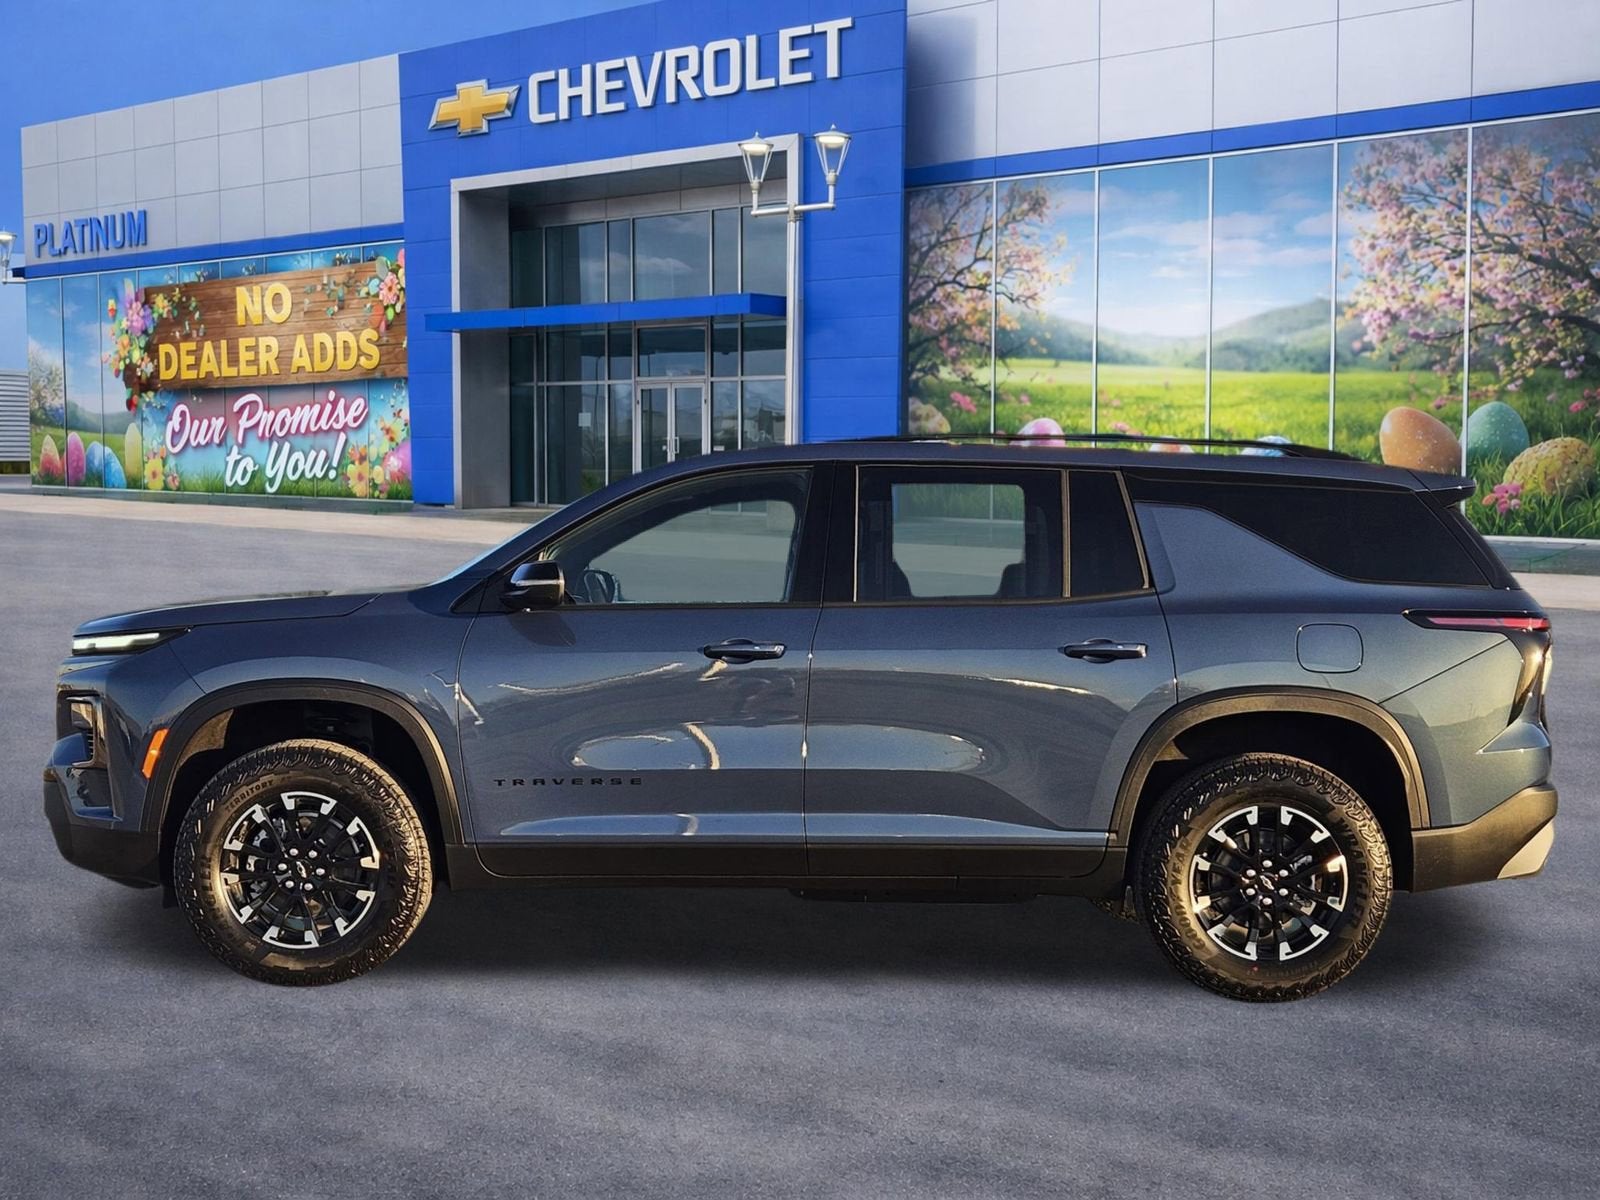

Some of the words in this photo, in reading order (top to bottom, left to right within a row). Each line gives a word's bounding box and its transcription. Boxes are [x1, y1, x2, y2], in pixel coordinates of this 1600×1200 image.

[527, 16, 855, 125] CHEVROLET
[33, 209, 148, 258] PLATINUM
[235, 282, 293, 326] NO
[158, 335, 280, 380] DEALER
[290, 328, 382, 374] ADDS
[165, 403, 228, 455] Our
[232, 390, 369, 444] Promise
[225, 446, 259, 487] to
[264, 431, 347, 494] You!
[223, 775, 275, 814] TERRITORY
[494, 777, 642, 786] TRAVERSE
[1333, 815, 1368, 930] WRANGLER
